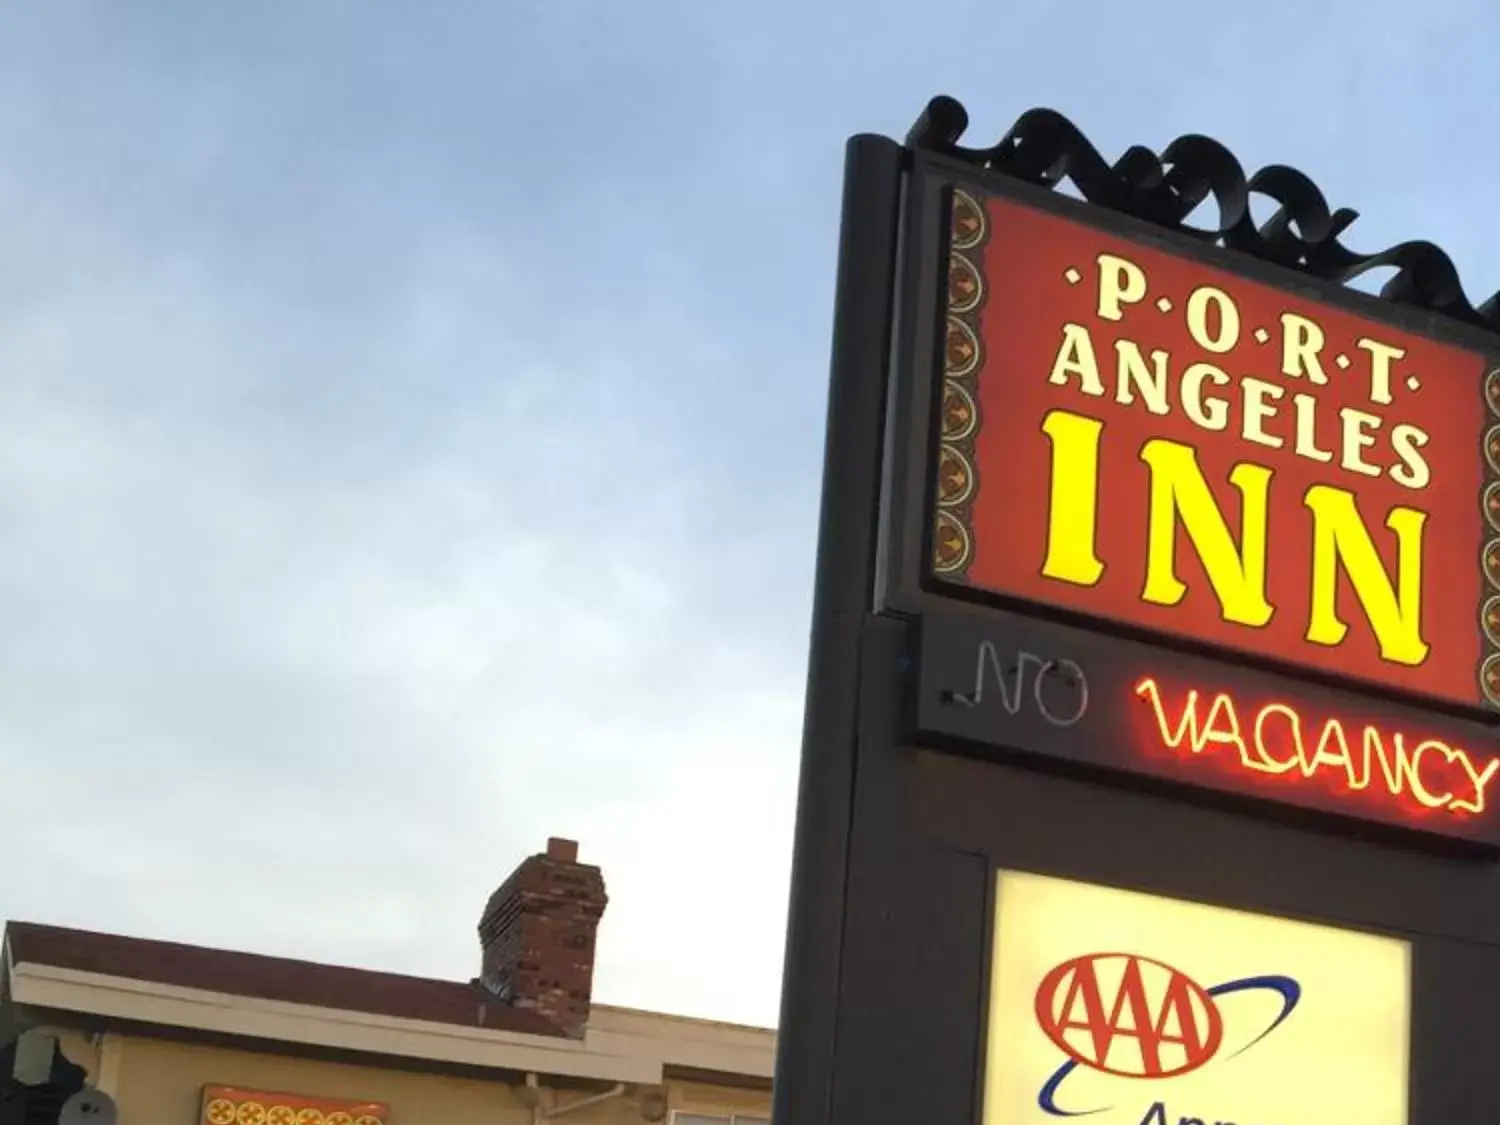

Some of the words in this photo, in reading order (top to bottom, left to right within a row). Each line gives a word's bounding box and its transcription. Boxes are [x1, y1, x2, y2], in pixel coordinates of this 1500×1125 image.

[1049, 322, 1431, 490] ANGELES
[1041, 410, 1431, 666] INN
[972, 640, 1088, 726] NO
[1135, 678, 1500, 813] VACANCY
[1050, 955, 1210, 1076] AAA
